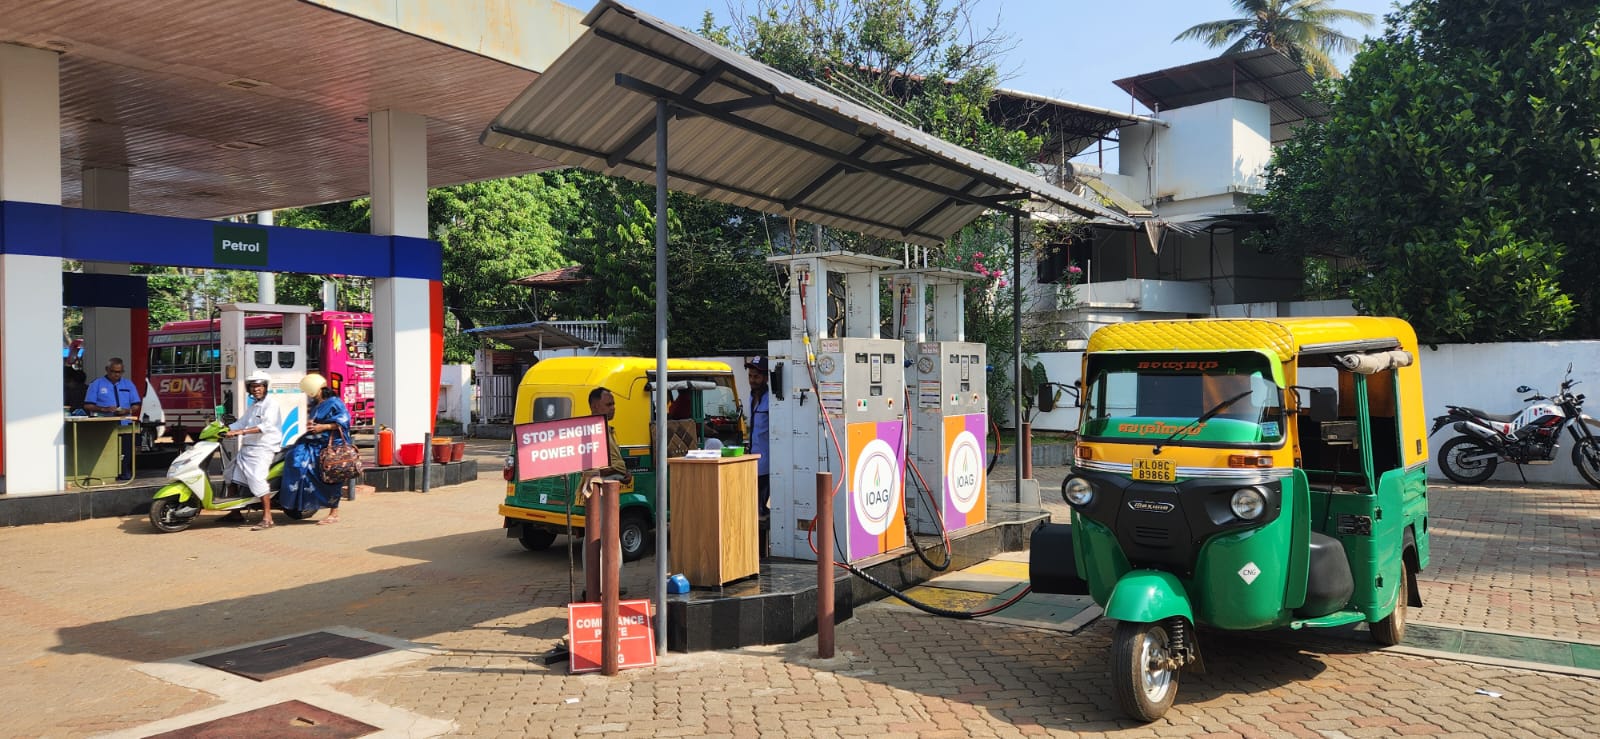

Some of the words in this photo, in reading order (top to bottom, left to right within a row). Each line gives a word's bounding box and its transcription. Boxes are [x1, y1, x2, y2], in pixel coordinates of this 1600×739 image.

[222, 239, 260, 252] Petrol
[160, 378, 206, 393] SONA
[522, 429, 556, 445] STOP
[558, 423, 603, 440] ENGINE
[531, 445, 576, 462] POWER
[578, 441, 600, 455] OFF
[957, 474, 975, 489] IOAG
[866, 488, 889, 506] IOAG
[576, 615, 645, 629] COMANCE
